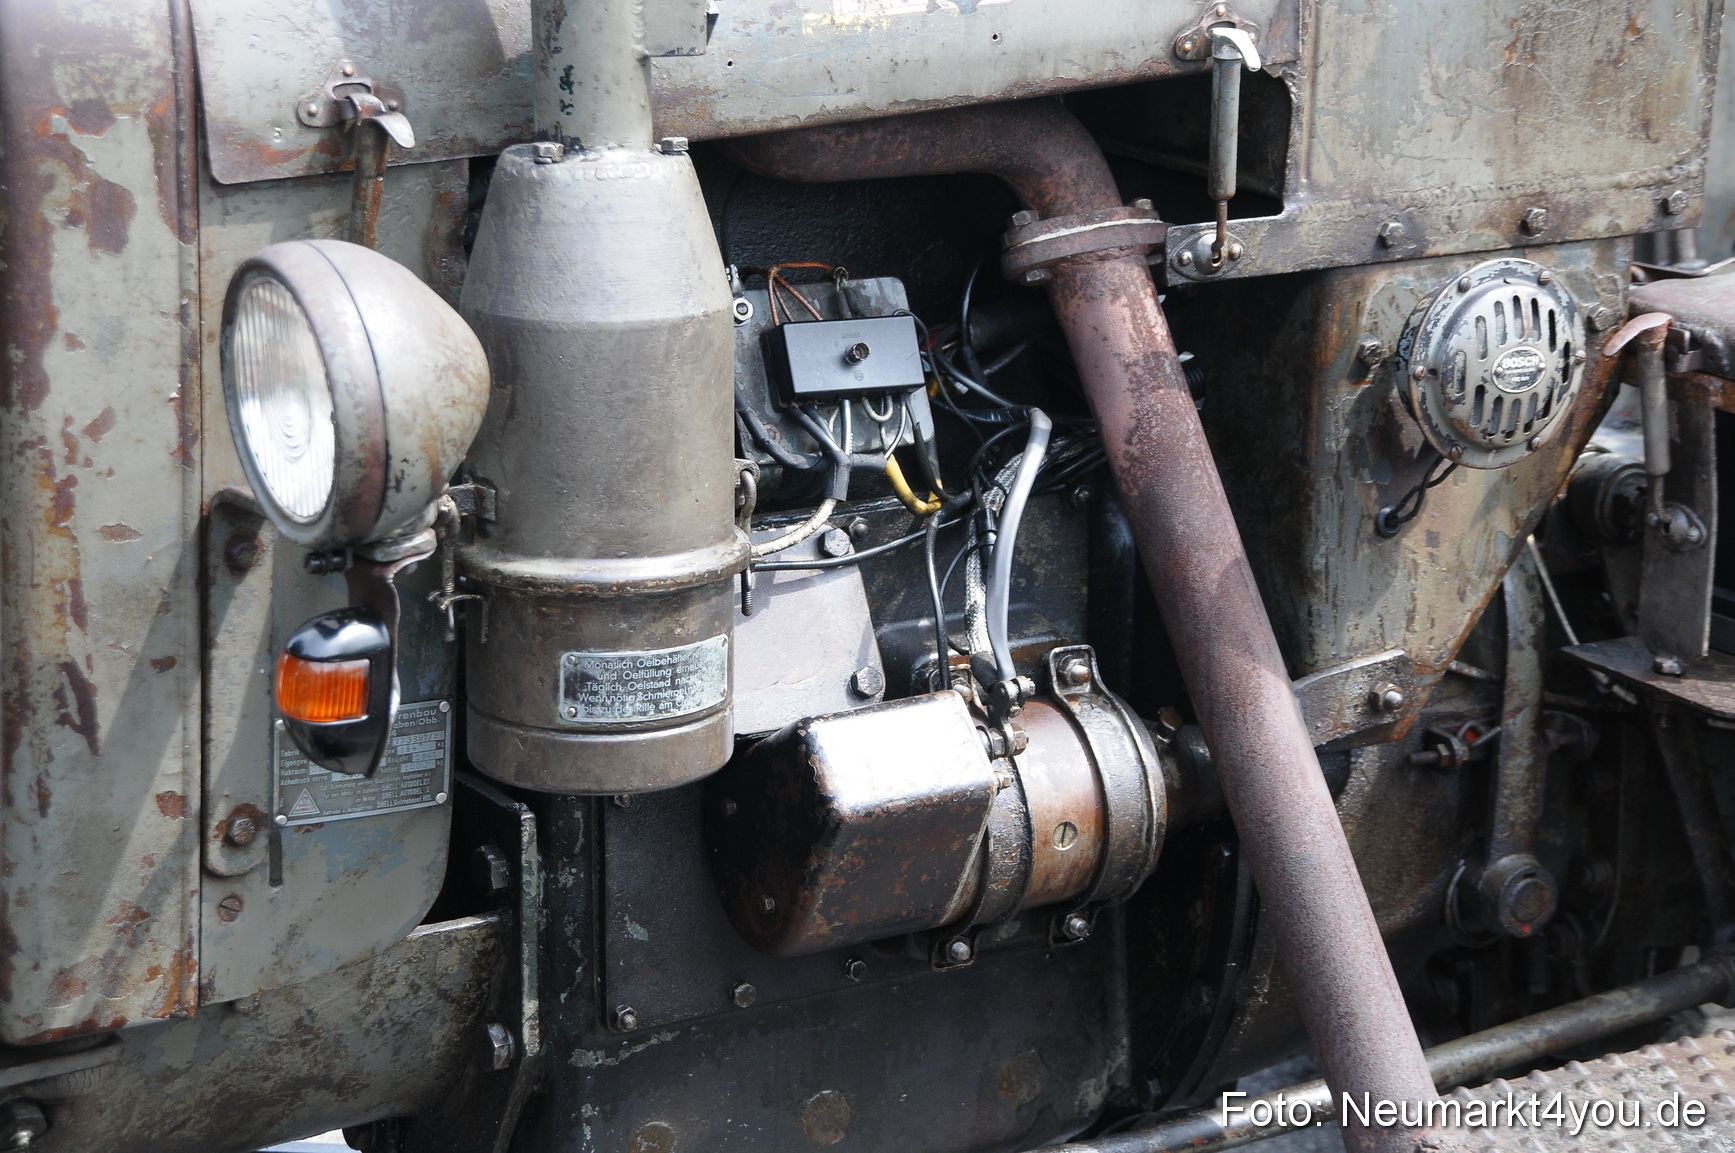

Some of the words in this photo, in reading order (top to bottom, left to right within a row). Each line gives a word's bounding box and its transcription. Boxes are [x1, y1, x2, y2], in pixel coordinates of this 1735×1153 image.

[1501, 355, 1540, 369] BOSCH
[584, 660, 633, 669] Monatlich
[636, 653, 691, 668] Oelbehälter
[597, 671, 618, 680] und
[623, 668, 672, 680] Oelfüllung
[628, 677, 671, 691] Oelstand
[578, 692, 608, 702] Wenn
[610, 693, 636, 704] nötig
[637, 686, 687, 701] Schmieroel
[396, 708, 437, 720] renbau
[601, 706, 612, 714] zu
[636, 702, 656, 712] Rille
[392, 716, 441, 729] aben/Obb.
[382, 783, 399, 791] SHELL
[381, 791, 399, 800] SHELL
[377, 799, 393, 809] SHELL
